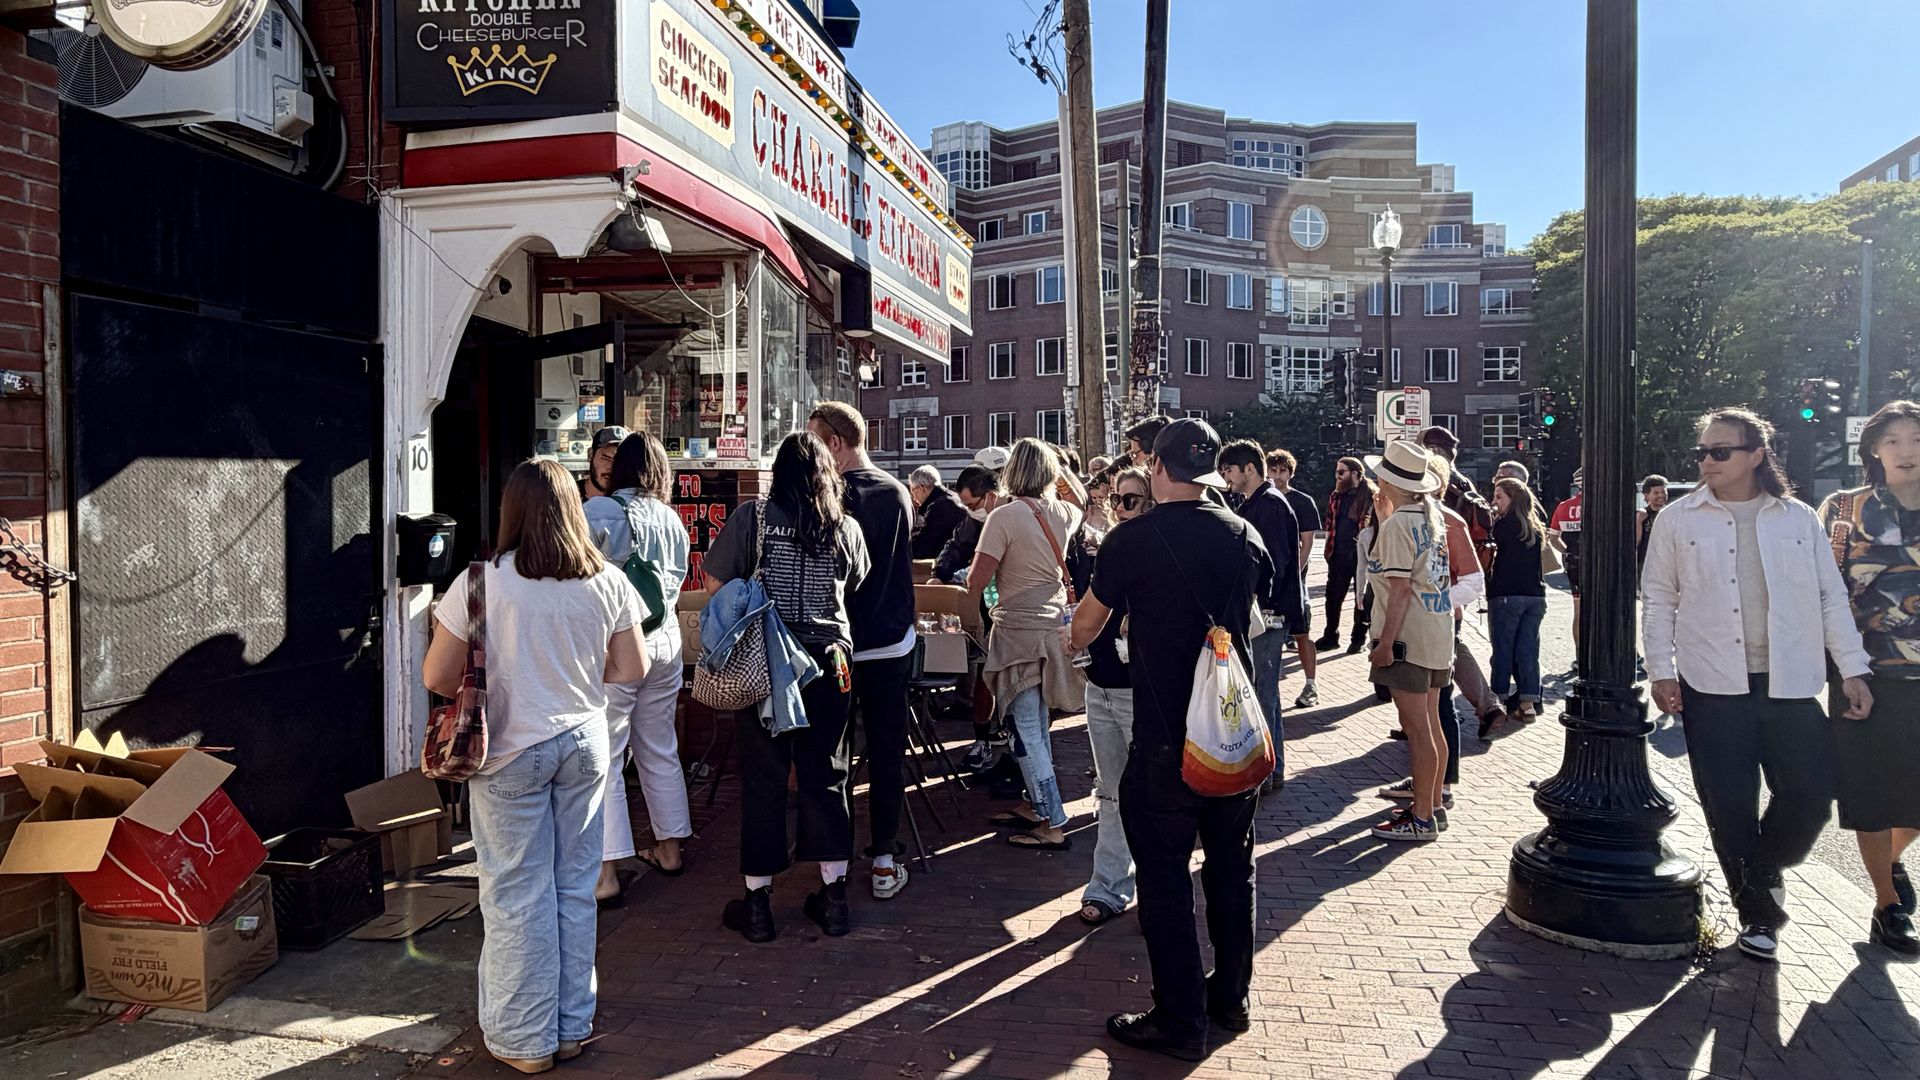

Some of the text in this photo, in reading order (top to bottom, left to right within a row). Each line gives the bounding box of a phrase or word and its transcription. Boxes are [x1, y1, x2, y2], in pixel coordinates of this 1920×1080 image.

[470, 13, 532, 26] DOUBLE
[416, 20, 587, 50] CHEESEBURGER
[661, 19, 727, 96] CHICKEN
[465, 67, 537, 86] KING
[659, 57, 731, 130] SEAFOOD
[878, 196, 941, 289] KITCHEN
[412, 446, 428, 472] 10
[679, 475, 701, 498] TO
[766, 525, 796, 538] EALIT
[112, 957, 168, 971] FIELD FRY
